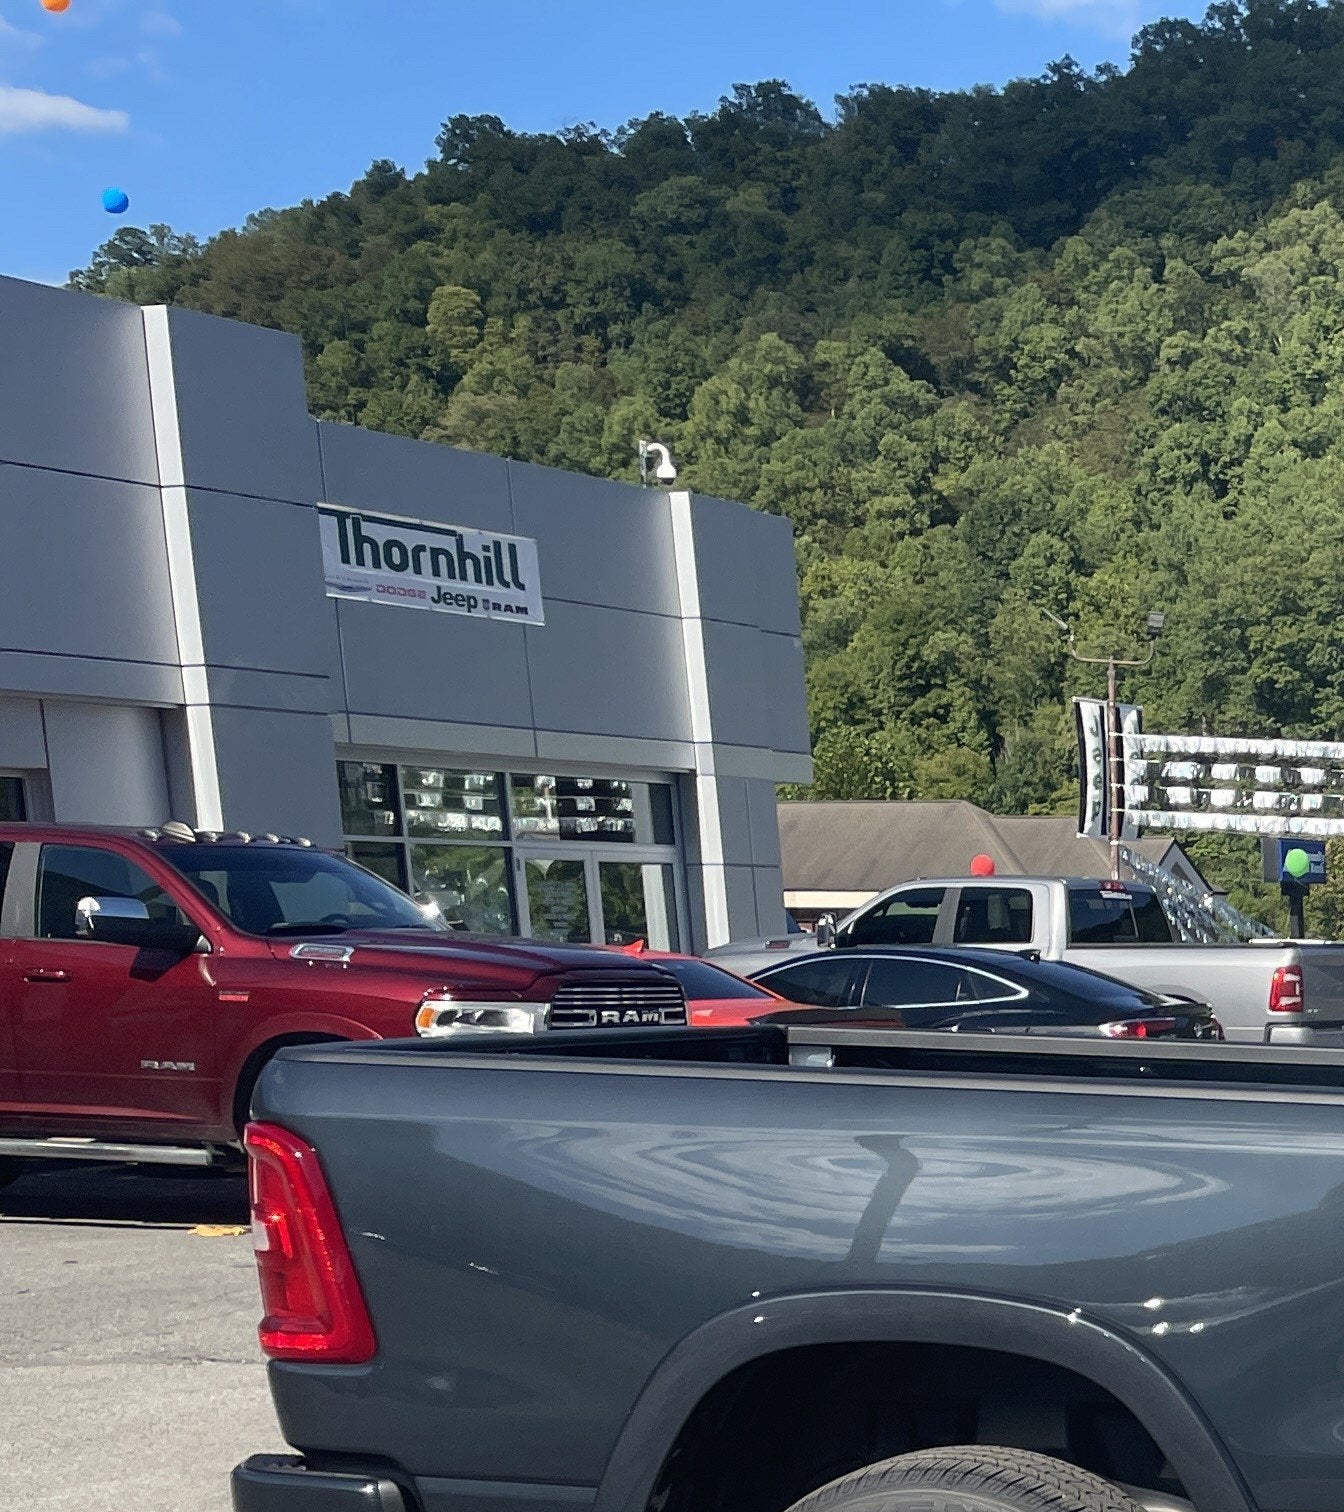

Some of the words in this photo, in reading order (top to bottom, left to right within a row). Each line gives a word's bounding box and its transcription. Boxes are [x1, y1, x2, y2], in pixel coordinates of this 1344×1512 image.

[318, 505, 526, 591] Thornhill
[375, 583, 427, 599] DODGE
[430, 585, 478, 613] Jeep
[491, 602, 529, 616] RAM
[601, 1009, 660, 1024] RAM
[140, 1060, 196, 1071] RAM
